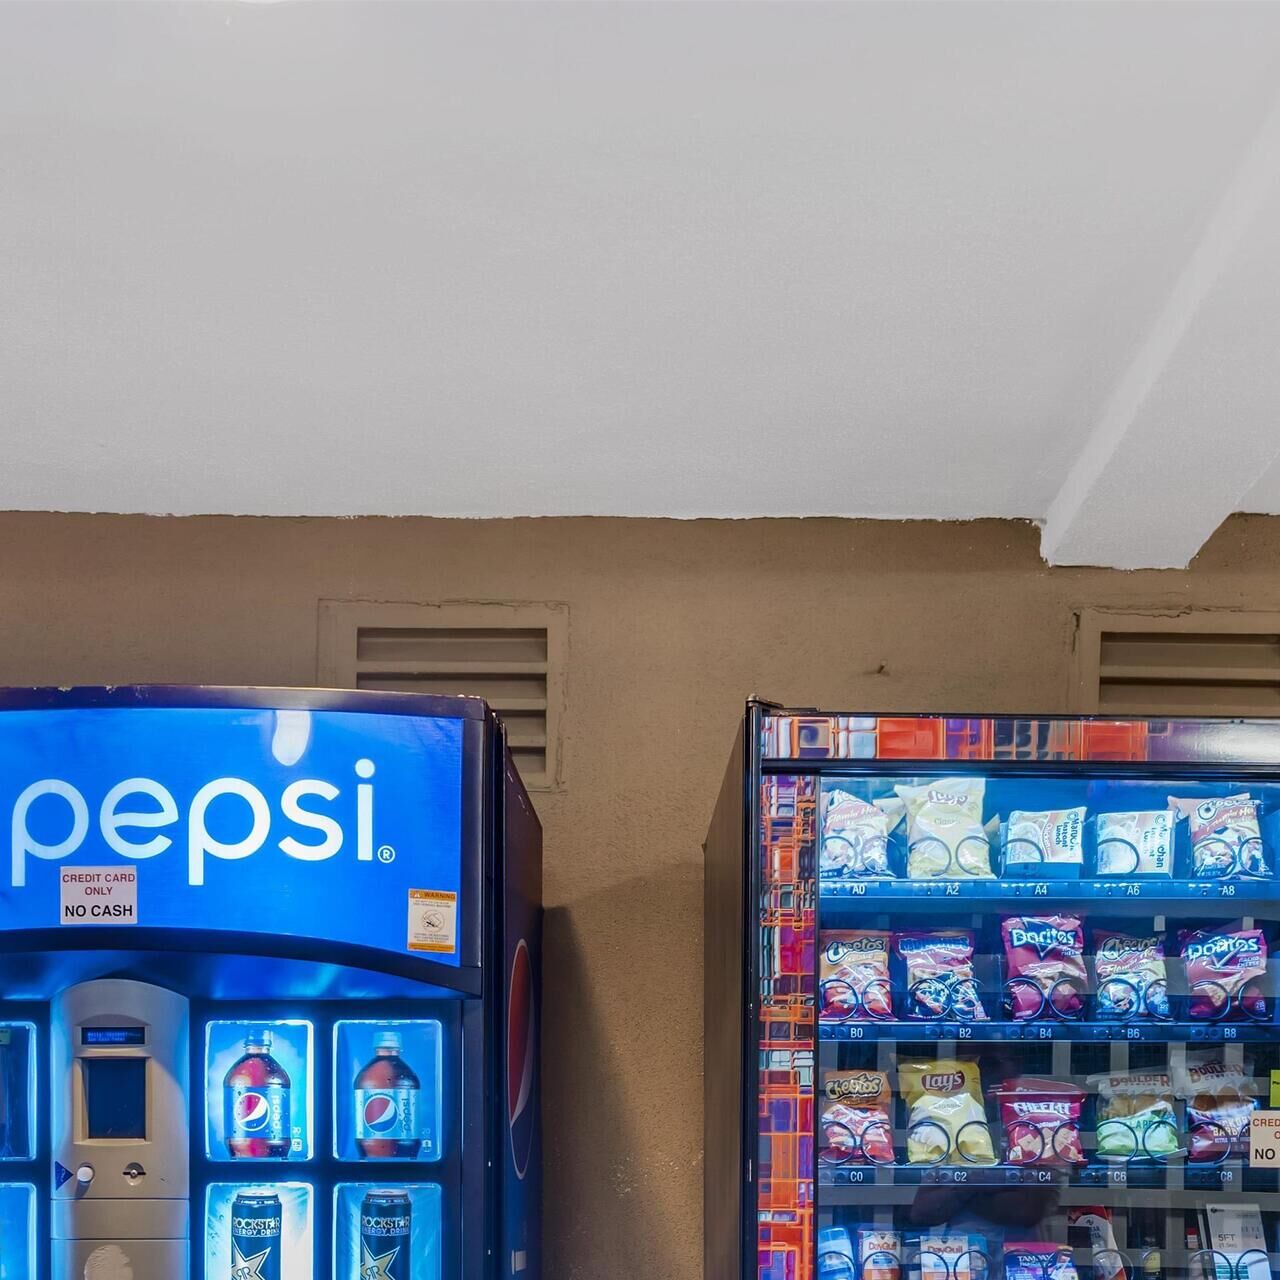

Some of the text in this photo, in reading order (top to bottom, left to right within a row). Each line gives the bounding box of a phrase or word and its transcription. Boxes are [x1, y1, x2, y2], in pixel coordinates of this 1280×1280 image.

[11, 758, 374, 887] pepsi
[62, 873, 136, 884] CREDIT CARD
[84, 886, 113, 896] ONLY
[946, 885, 959, 895] A2
[1035, 885, 1047, 895] A4
[1127, 886, 1140, 896] A6
[1222, 886, 1235, 896] A8
[64, 904, 133, 917] NO CASH
[1012, 928, 1076, 947] Doritos
[1188, 936, 1260, 961] Doritos
[959, 1028, 971, 1038] B2
[1040, 1028, 1052, 1038] B4
[1127, 1029, 1139, 1038] B6
[1224, 1029, 1236, 1038] B8
[826, 1073, 883, 1099] Cheetos
[1110, 1075, 1170, 1088] BOULDER
[272, 1095, 282, 1130] pepsi
[1254, 1149, 1276, 1160] NO
[954, 1172, 967, 1182] C2
[1039, 1172, 1051, 1182] C4
[1114, 1171, 1127, 1182] C6
[1220, 1171, 1233, 1181] C8
[1218, 1233, 1236, 1242] 5FT
[868, 1241, 898, 1252] DayQuil
